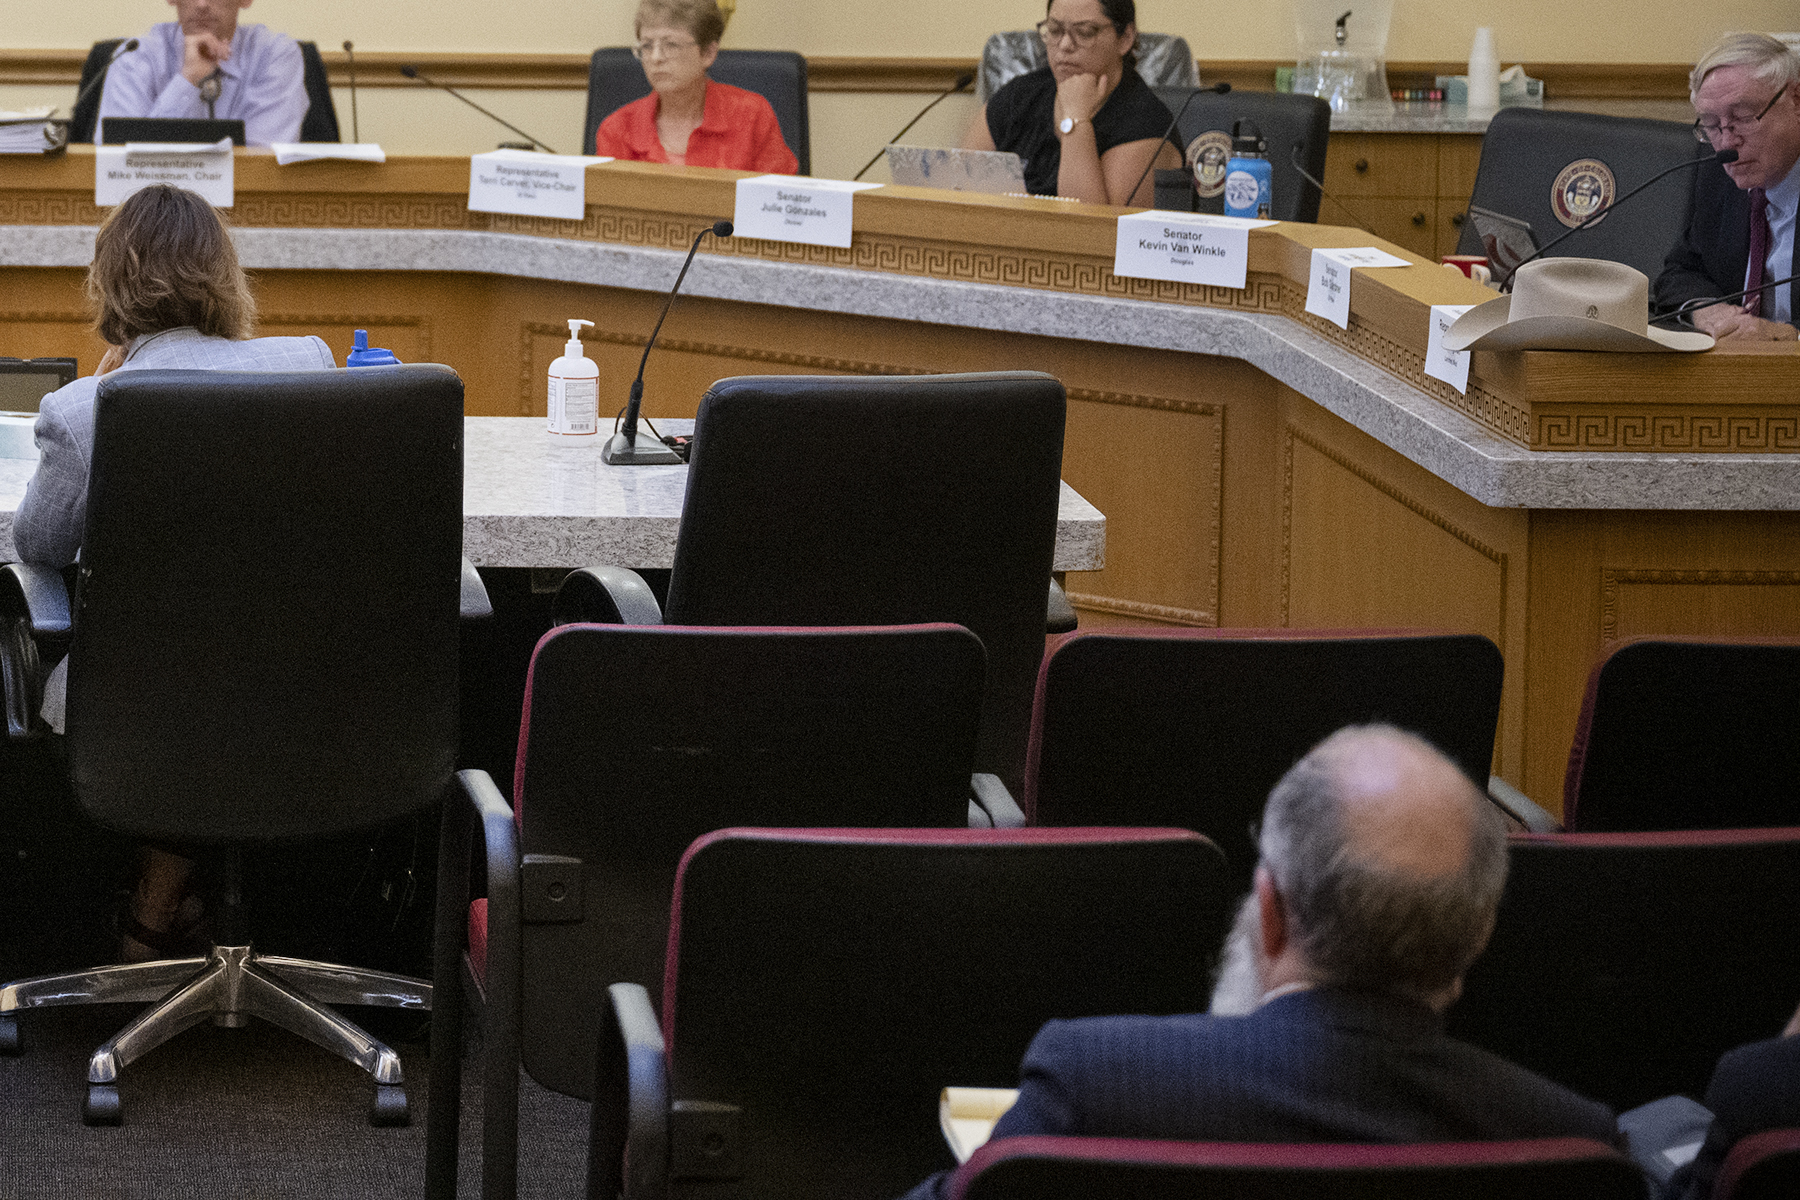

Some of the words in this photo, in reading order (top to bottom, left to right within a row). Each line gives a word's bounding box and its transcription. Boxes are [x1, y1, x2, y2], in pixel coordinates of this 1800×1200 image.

[126, 159, 205, 169] Representative
[107, 171, 132, 180] Mike
[194, 171, 222, 181] Chair
[496, 165, 559, 178] Representative
[777, 191, 812, 203] Senator
[1163, 228, 1203, 241] Senator
[1139, 239, 1168, 251] Kevin
[1170, 241, 1190, 253] Van
[1192, 244, 1226, 257] Winkle
